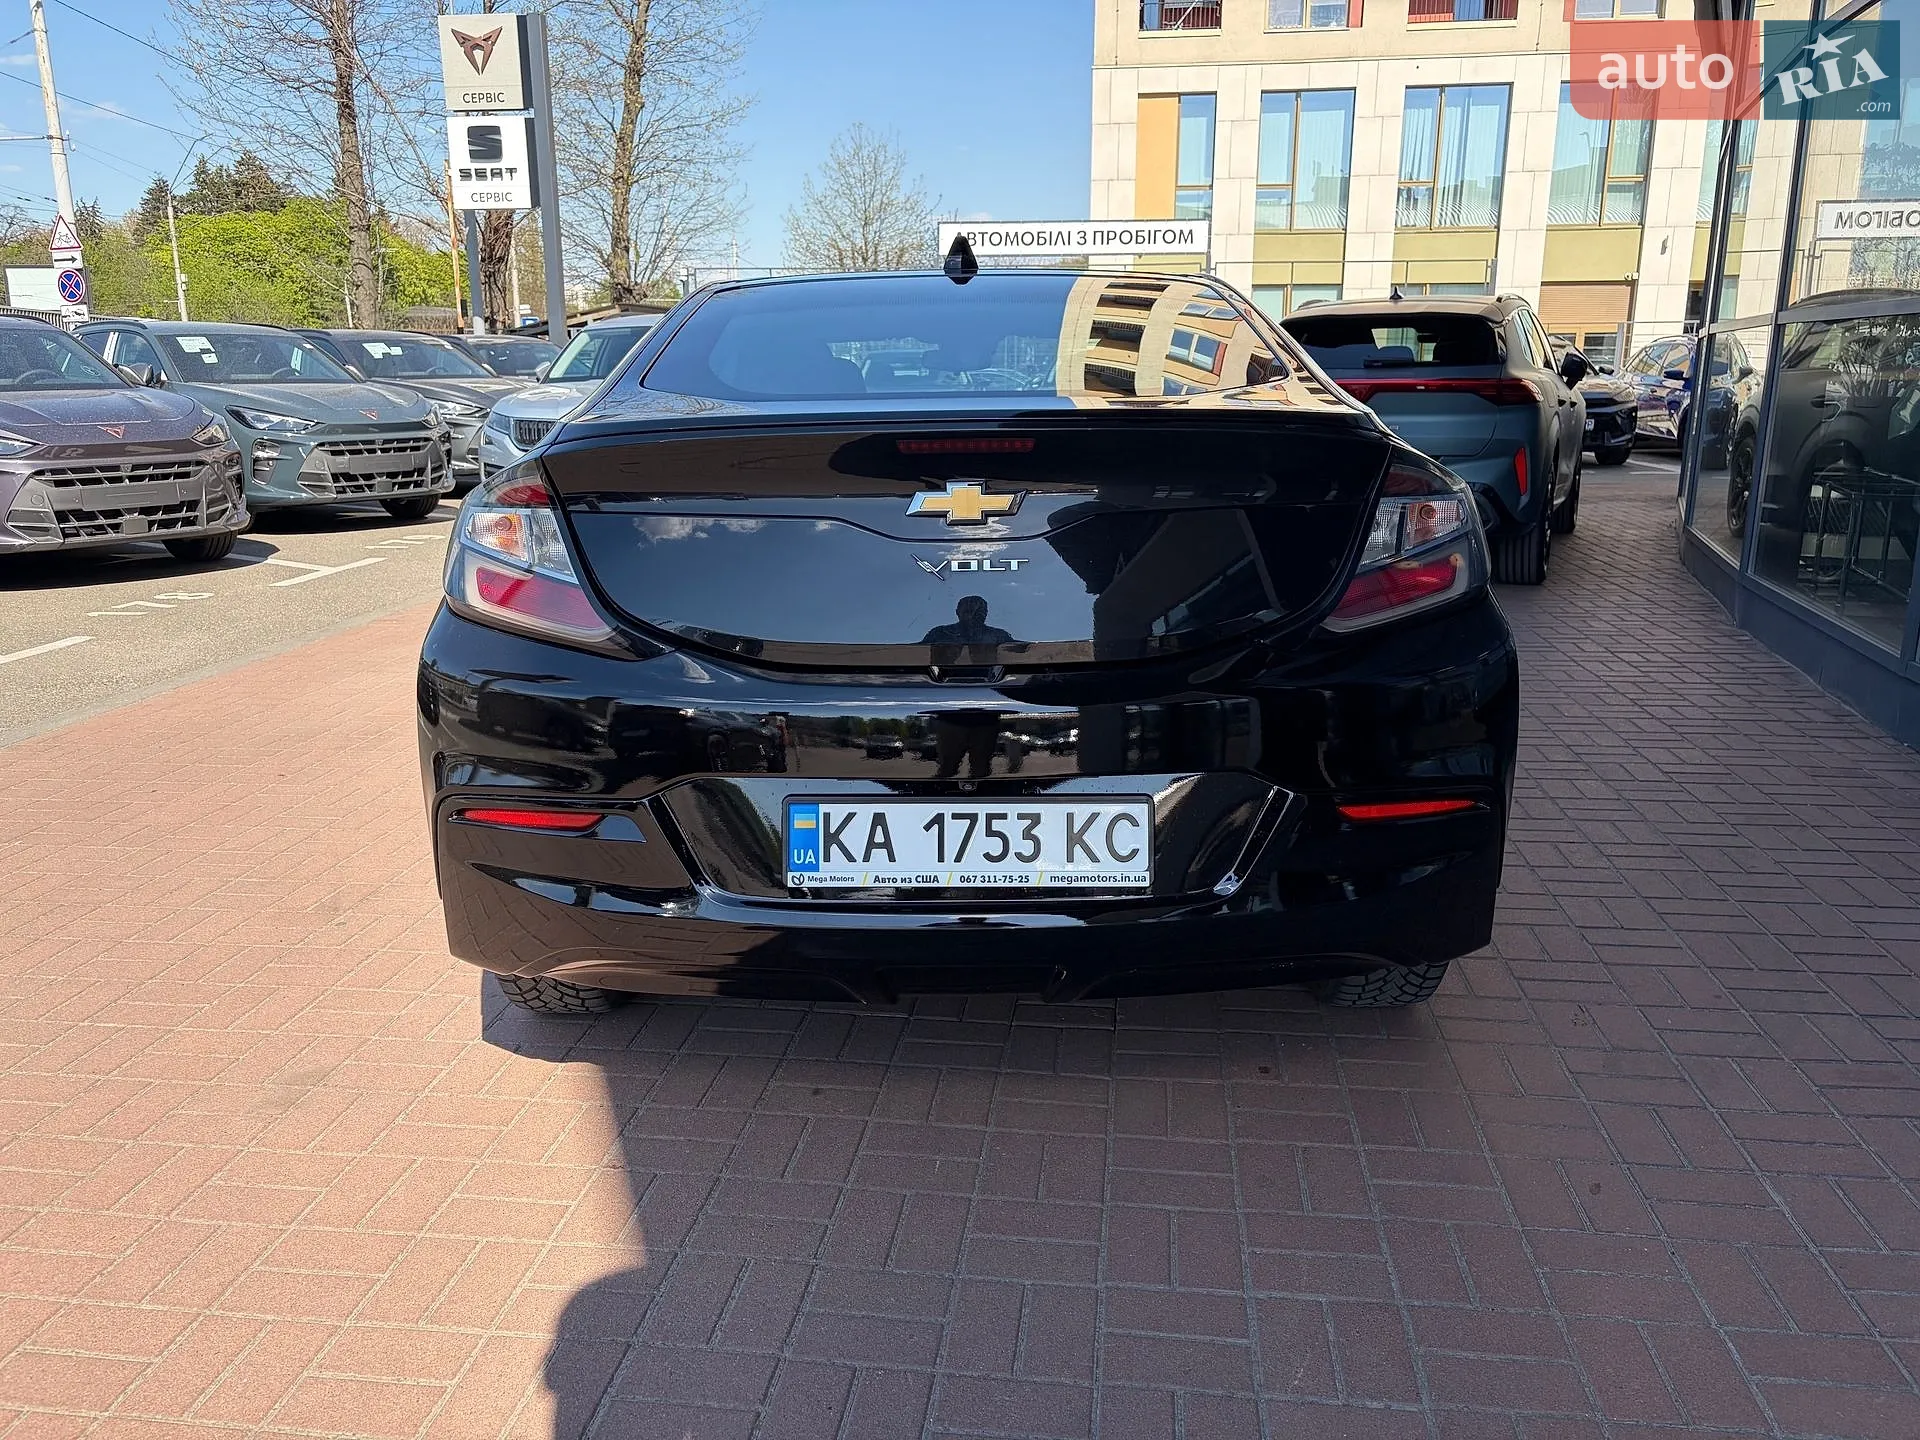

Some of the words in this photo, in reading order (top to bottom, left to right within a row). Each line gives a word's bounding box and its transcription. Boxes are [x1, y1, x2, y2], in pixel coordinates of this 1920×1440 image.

[462, 92, 505, 104] СЕРВІС
[458, 167, 518, 182] SEAT
[470, 192, 513, 203] СЕРВІС
[956, 230, 1072, 247] ВТОМОБІЛІ
[1092, 228, 1194, 246] ПРОБІГОМ
[910, 553, 1029, 582] VOLT
[823, 812, 897, 863] KA
[922, 812, 1042, 863] 1753
[1066, 812, 1140, 863] KC
[793, 849, 816, 864] UA
[807, 875, 828, 884] Mega
[829, 875, 855, 883] Motors
[873, 875, 898, 884] Авто
[914, 875, 940, 884] США
[959, 875, 977, 884] 067
[980, 875, 1030, 884] 311-75-25
[1050, 873, 1147, 885] megamotors.in.ua
